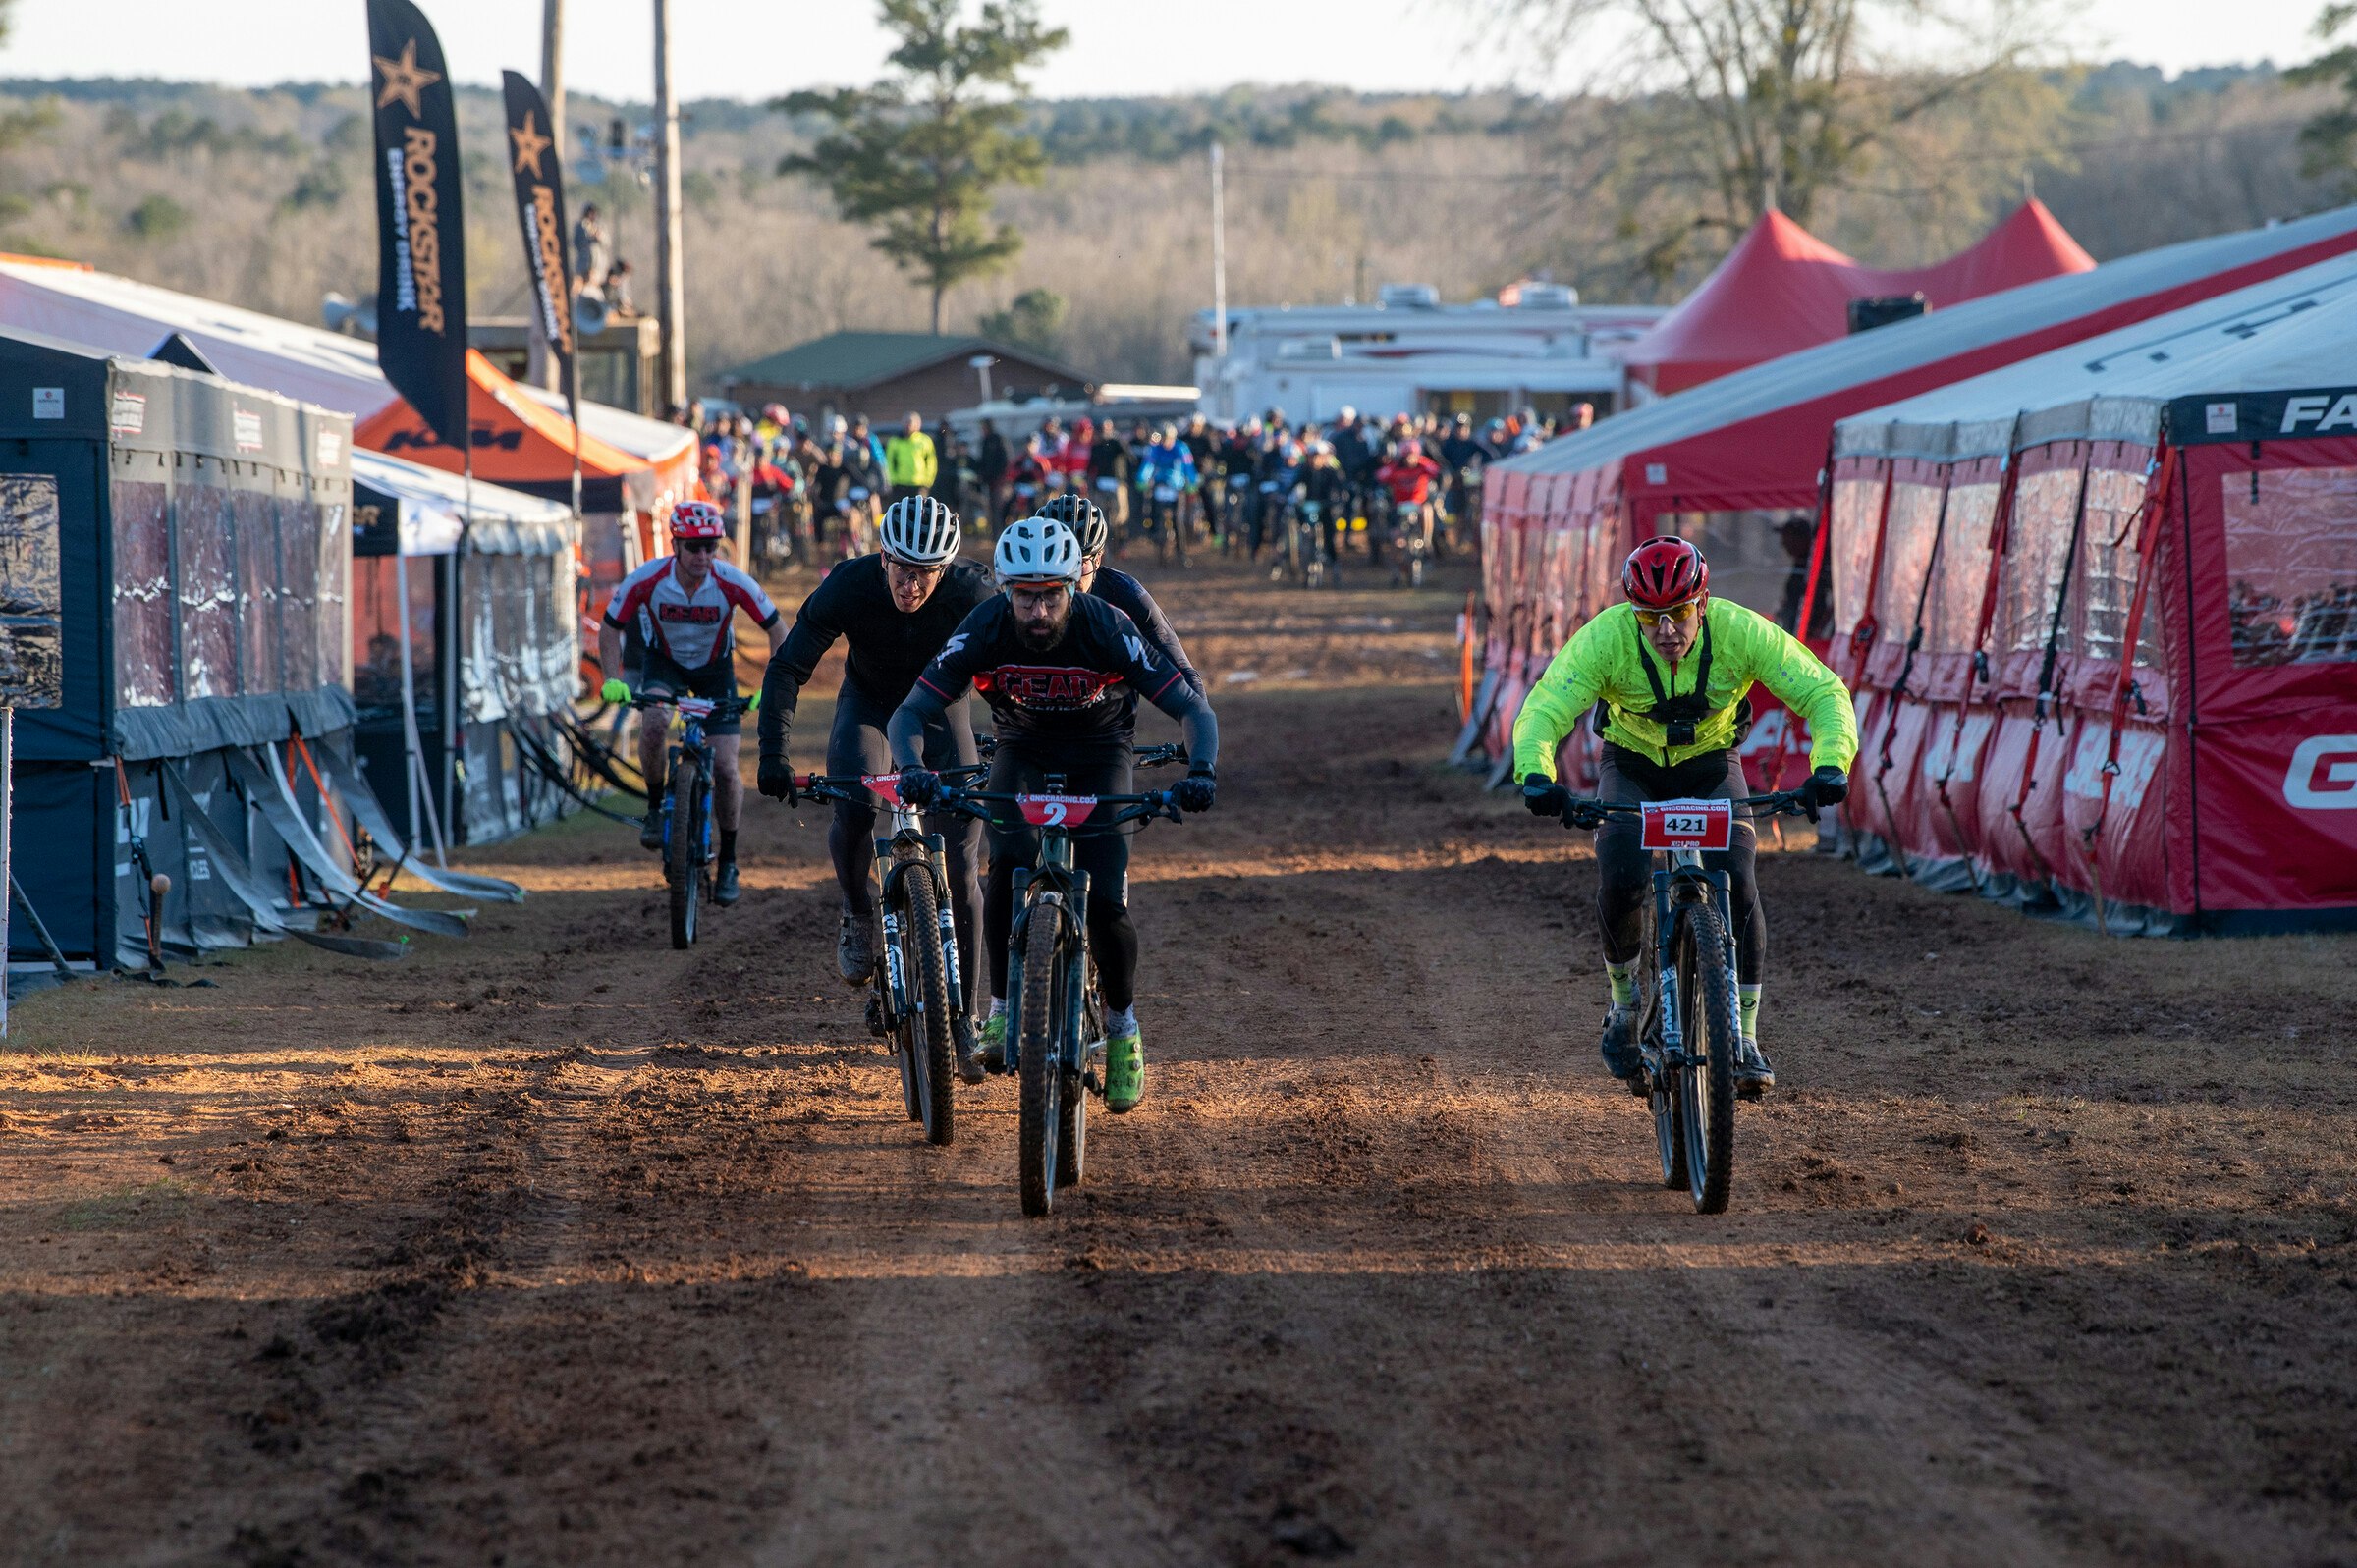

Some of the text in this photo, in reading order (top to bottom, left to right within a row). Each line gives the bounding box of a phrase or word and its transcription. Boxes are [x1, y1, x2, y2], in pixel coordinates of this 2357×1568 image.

[387, 147, 409, 238] ENERGY
[403, 126, 445, 333] ROCKSTAR
[531, 185, 573, 355] ROCKSTAR
[1043, 802, 1068, 826] 2
[1666, 818, 1705, 832] 421
